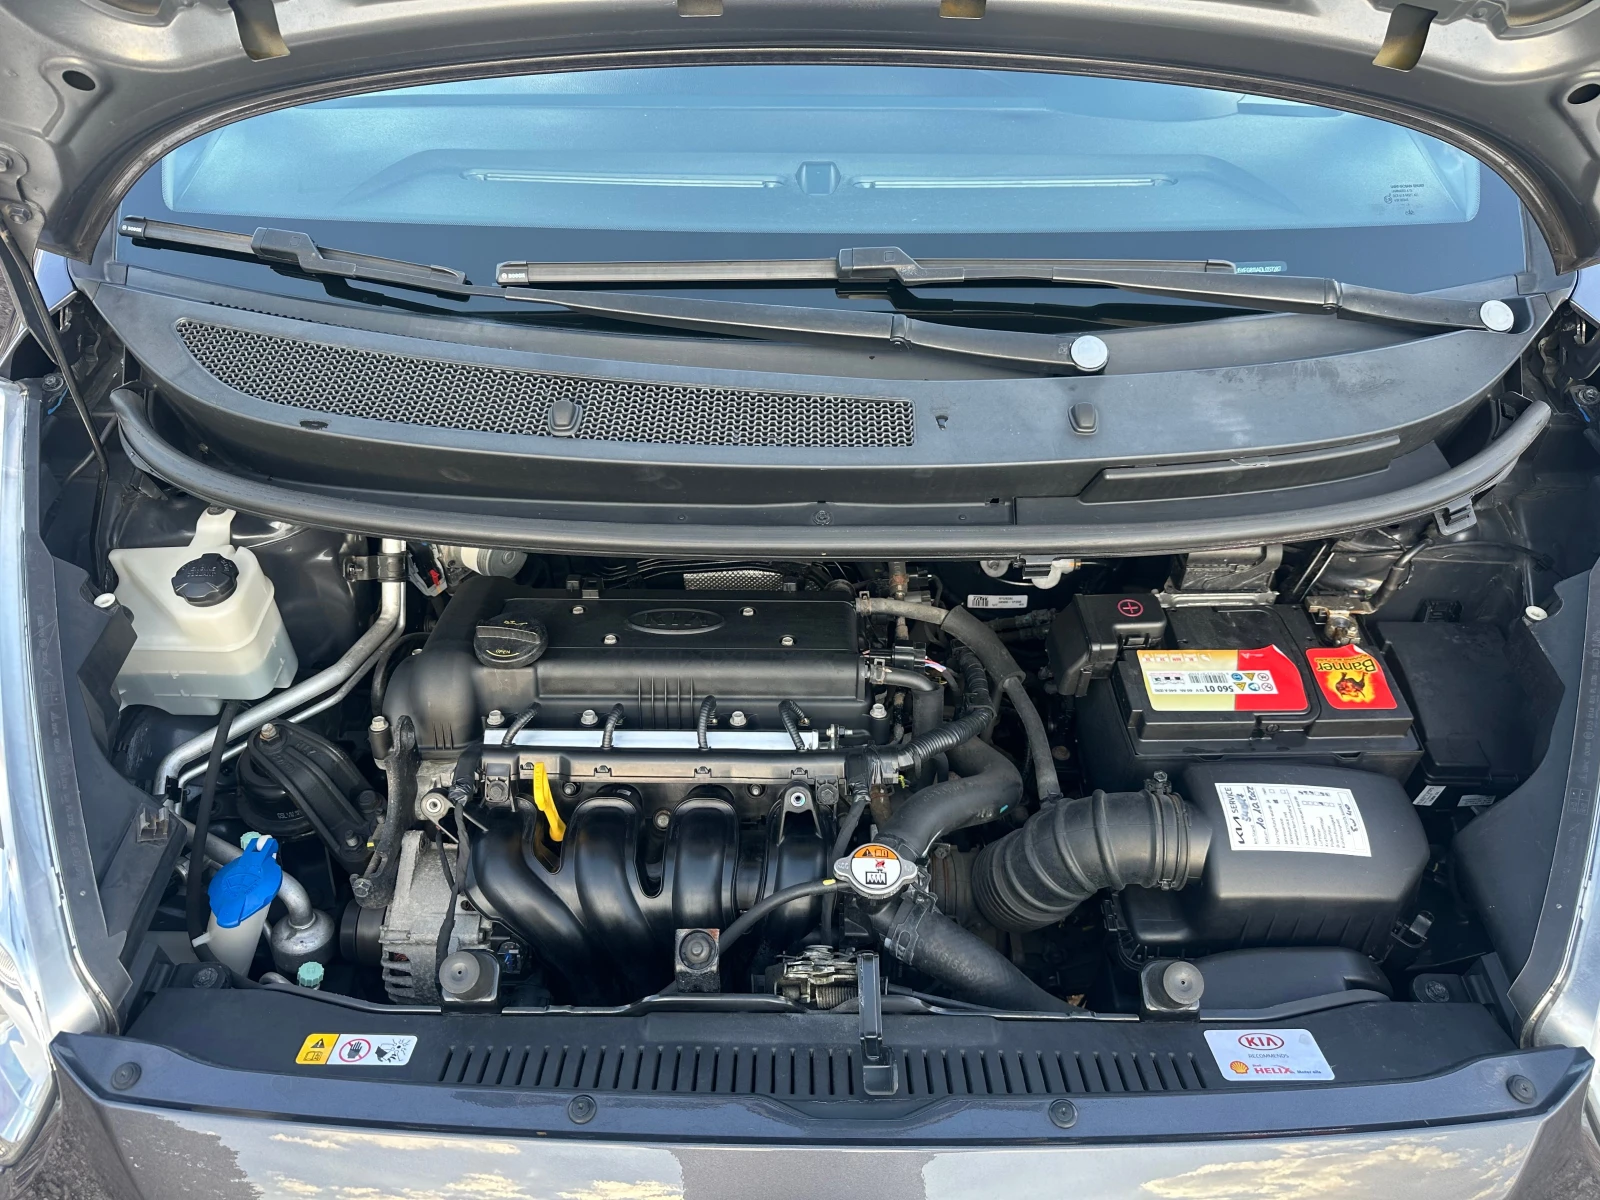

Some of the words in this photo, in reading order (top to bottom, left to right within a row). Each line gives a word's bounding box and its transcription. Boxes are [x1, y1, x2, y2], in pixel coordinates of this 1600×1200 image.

[1317, 658, 1376, 672] Banner
[1225, 787, 1239, 813] SERVICE
[1245, 1037, 1278, 1046] KIA
[1254, 1066, 1295, 1074] HELIX
